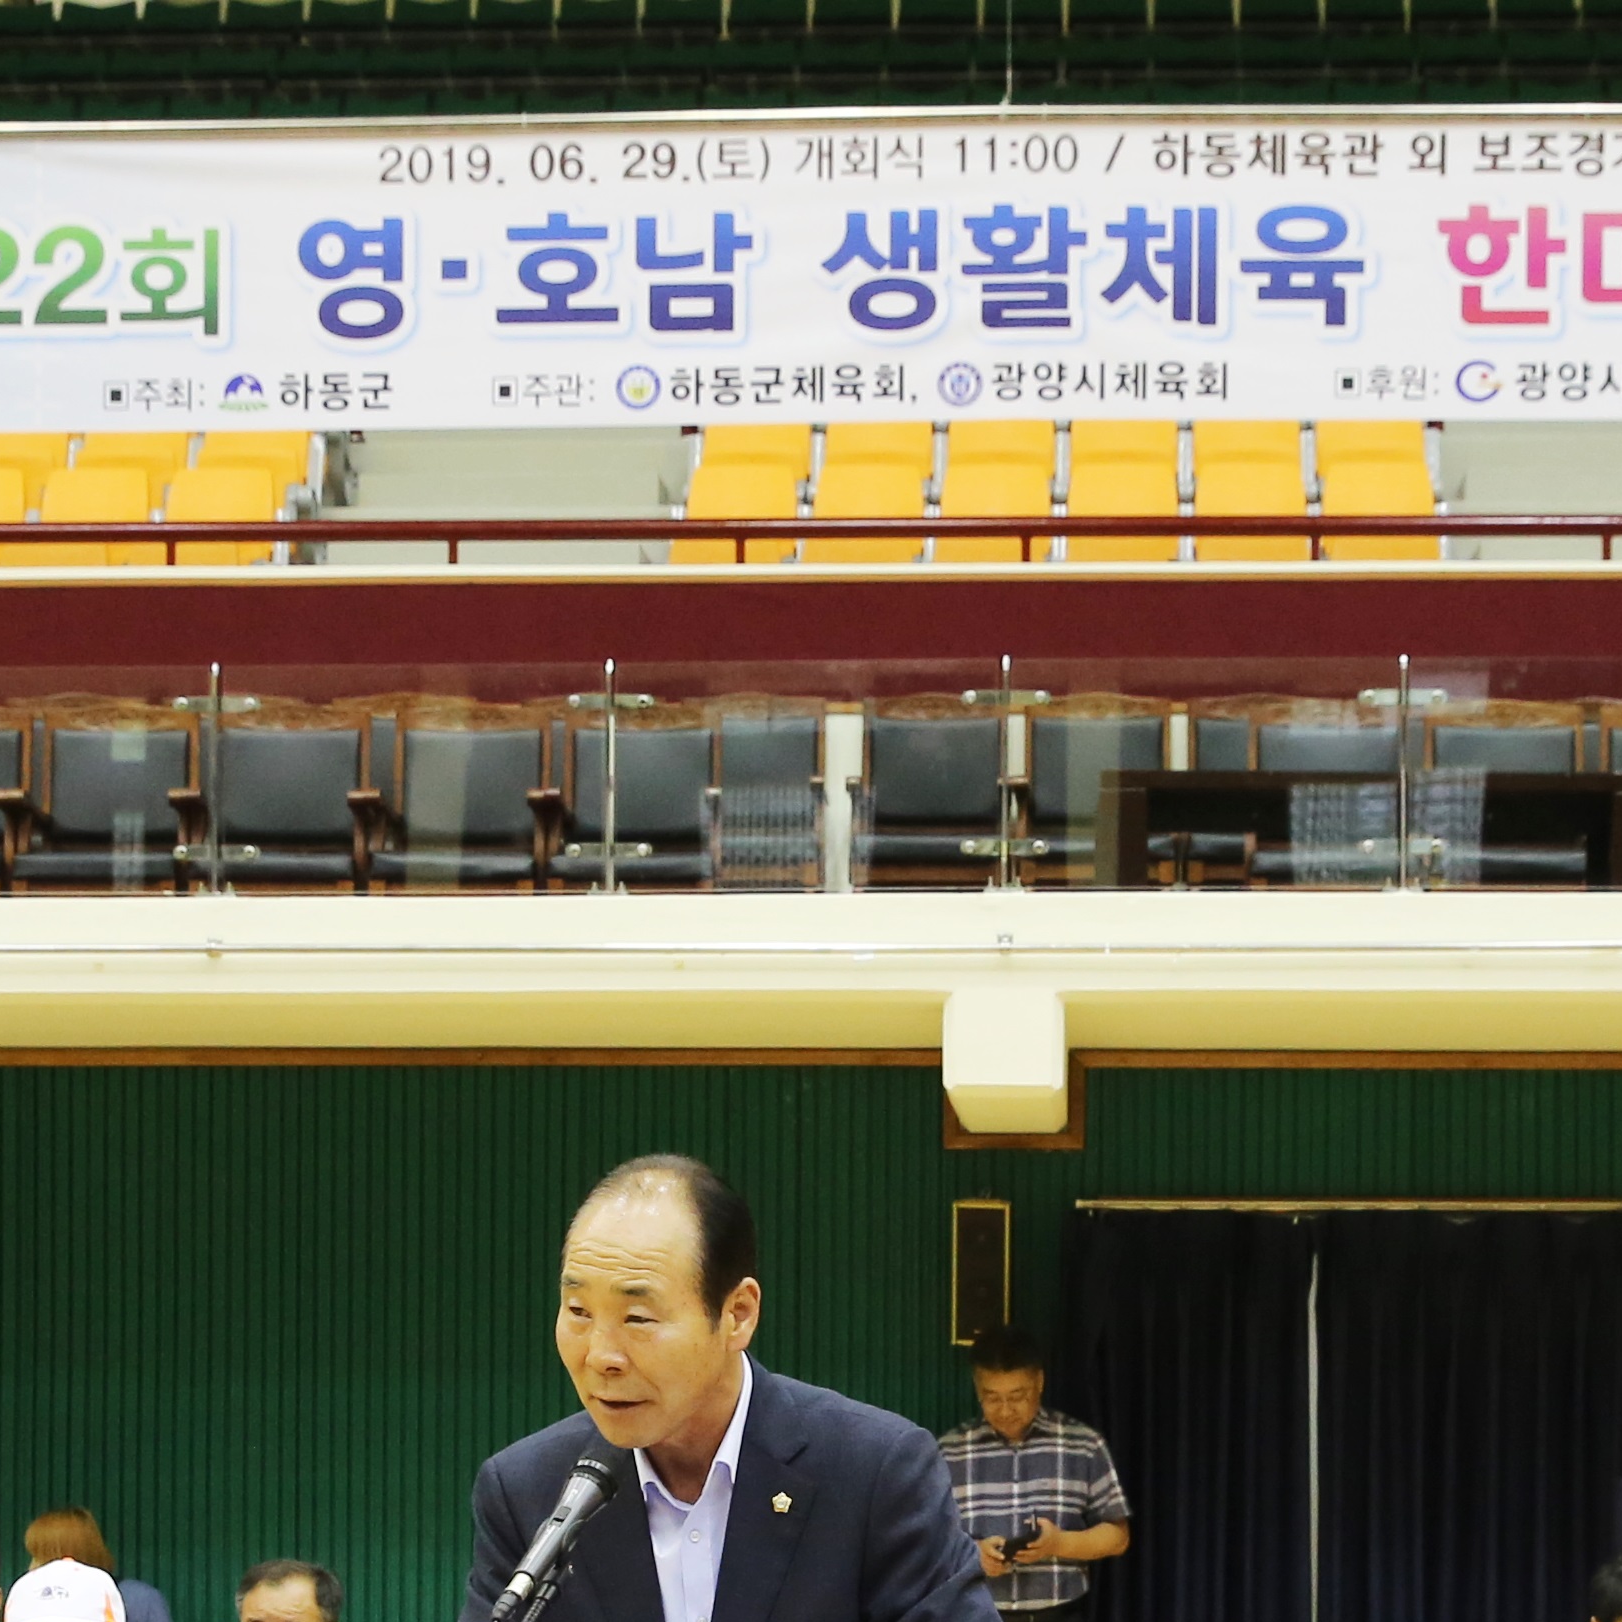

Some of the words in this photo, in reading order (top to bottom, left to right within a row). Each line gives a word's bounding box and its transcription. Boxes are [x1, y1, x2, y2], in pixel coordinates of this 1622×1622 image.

[377, 143, 506, 186] 2019.
[529, 143, 597, 183] 06.
[622, 139, 770, 182] 29.(토)
[793, 135, 925, 179] 개회식
[955, 134, 1079, 173] 11:00
[1105, 133, 1125, 173] /
[1153, 132, 1384, 178] 하동체육관
[1409, 132, 1447, 176] 외
[297, 212, 754, 340] 영·호남
[821, 203, 1365, 331] 생활체육
[135, 379, 205, 412] 주최:
[280, 373, 392, 411] 하동군
[523, 374, 594, 407] 주관:
[671, 364, 917, 406] 하동군체육회,
[993, 362, 1228, 401] 광양시체육회
[1367, 365, 1439, 401] 후원:
